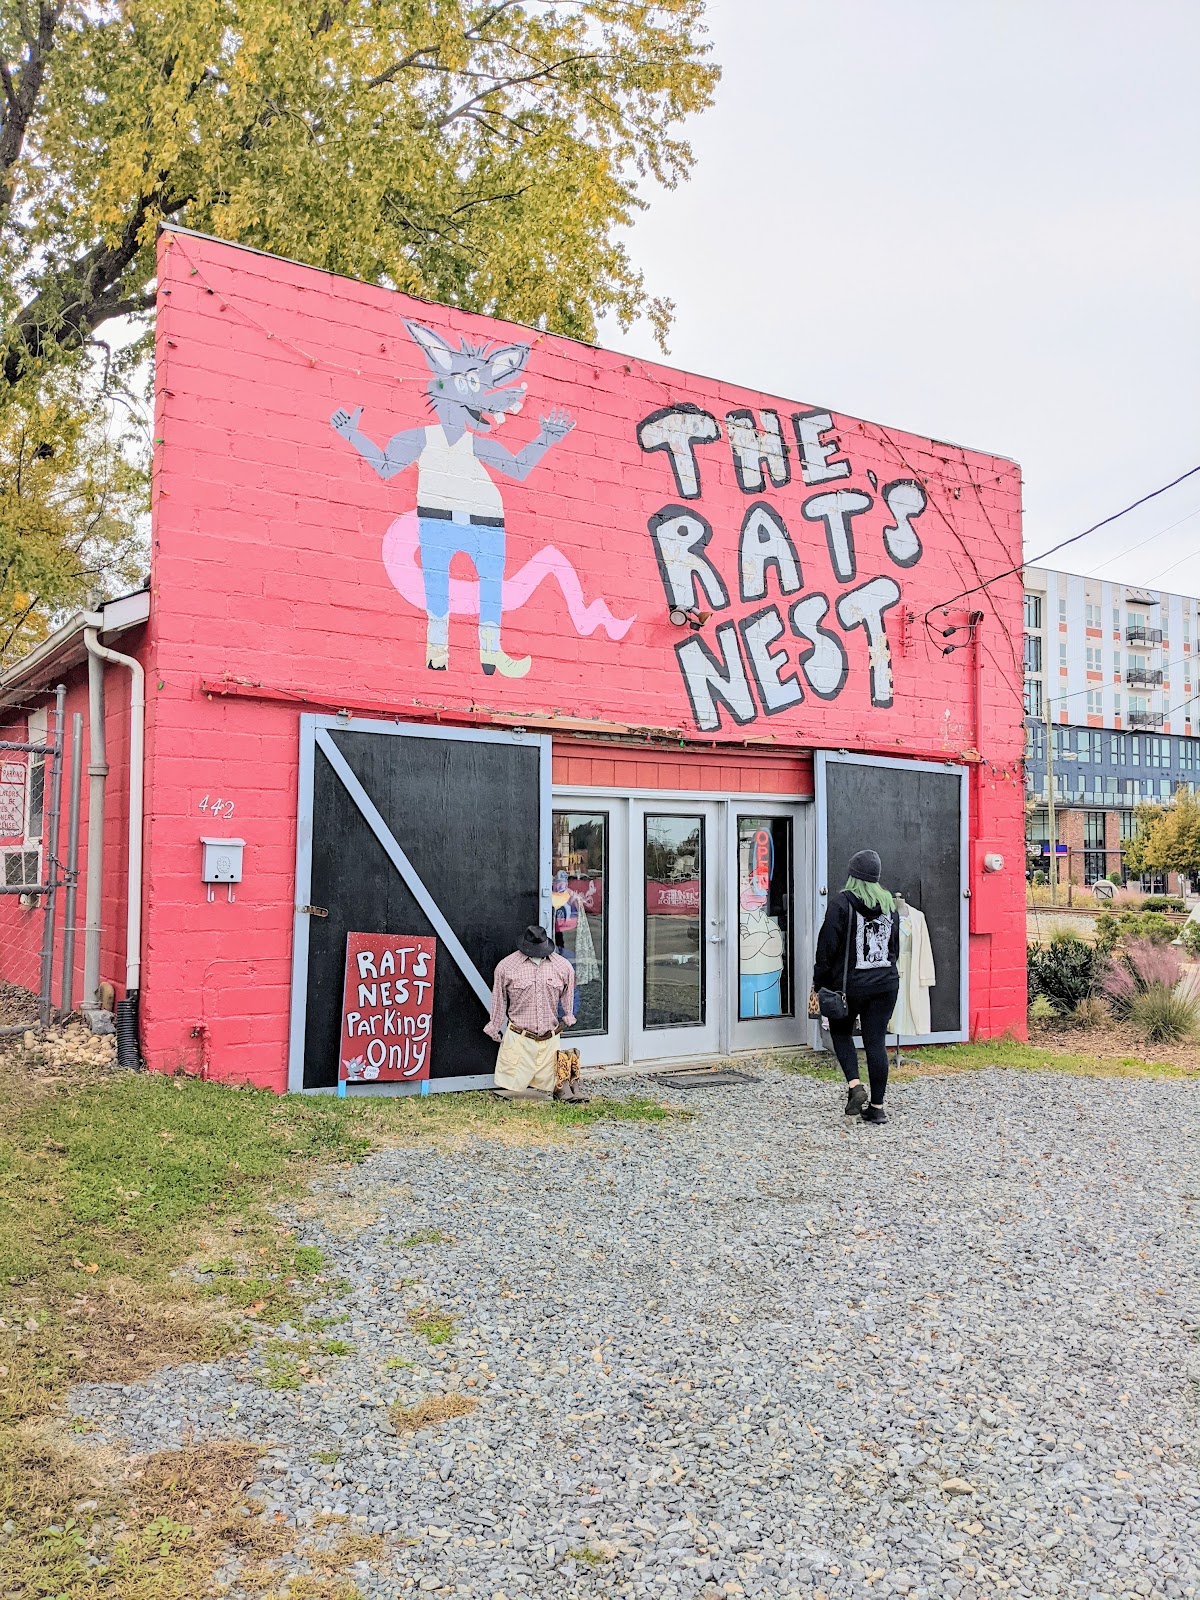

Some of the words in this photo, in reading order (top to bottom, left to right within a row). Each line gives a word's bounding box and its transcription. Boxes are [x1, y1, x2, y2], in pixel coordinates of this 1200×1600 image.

[636, 402, 852, 499] THE
[647, 469, 927, 611] RAT'S
[674, 575, 901, 732] NEST
[198, 794, 235, 819] 442
[755, 830, 769, 891] OPEN
[356, 943, 432, 979] RAT'S
[357, 978, 432, 1008] NEST
[346, 1008, 433, 1042] Parking
[366, 1037, 428, 1077] Only
